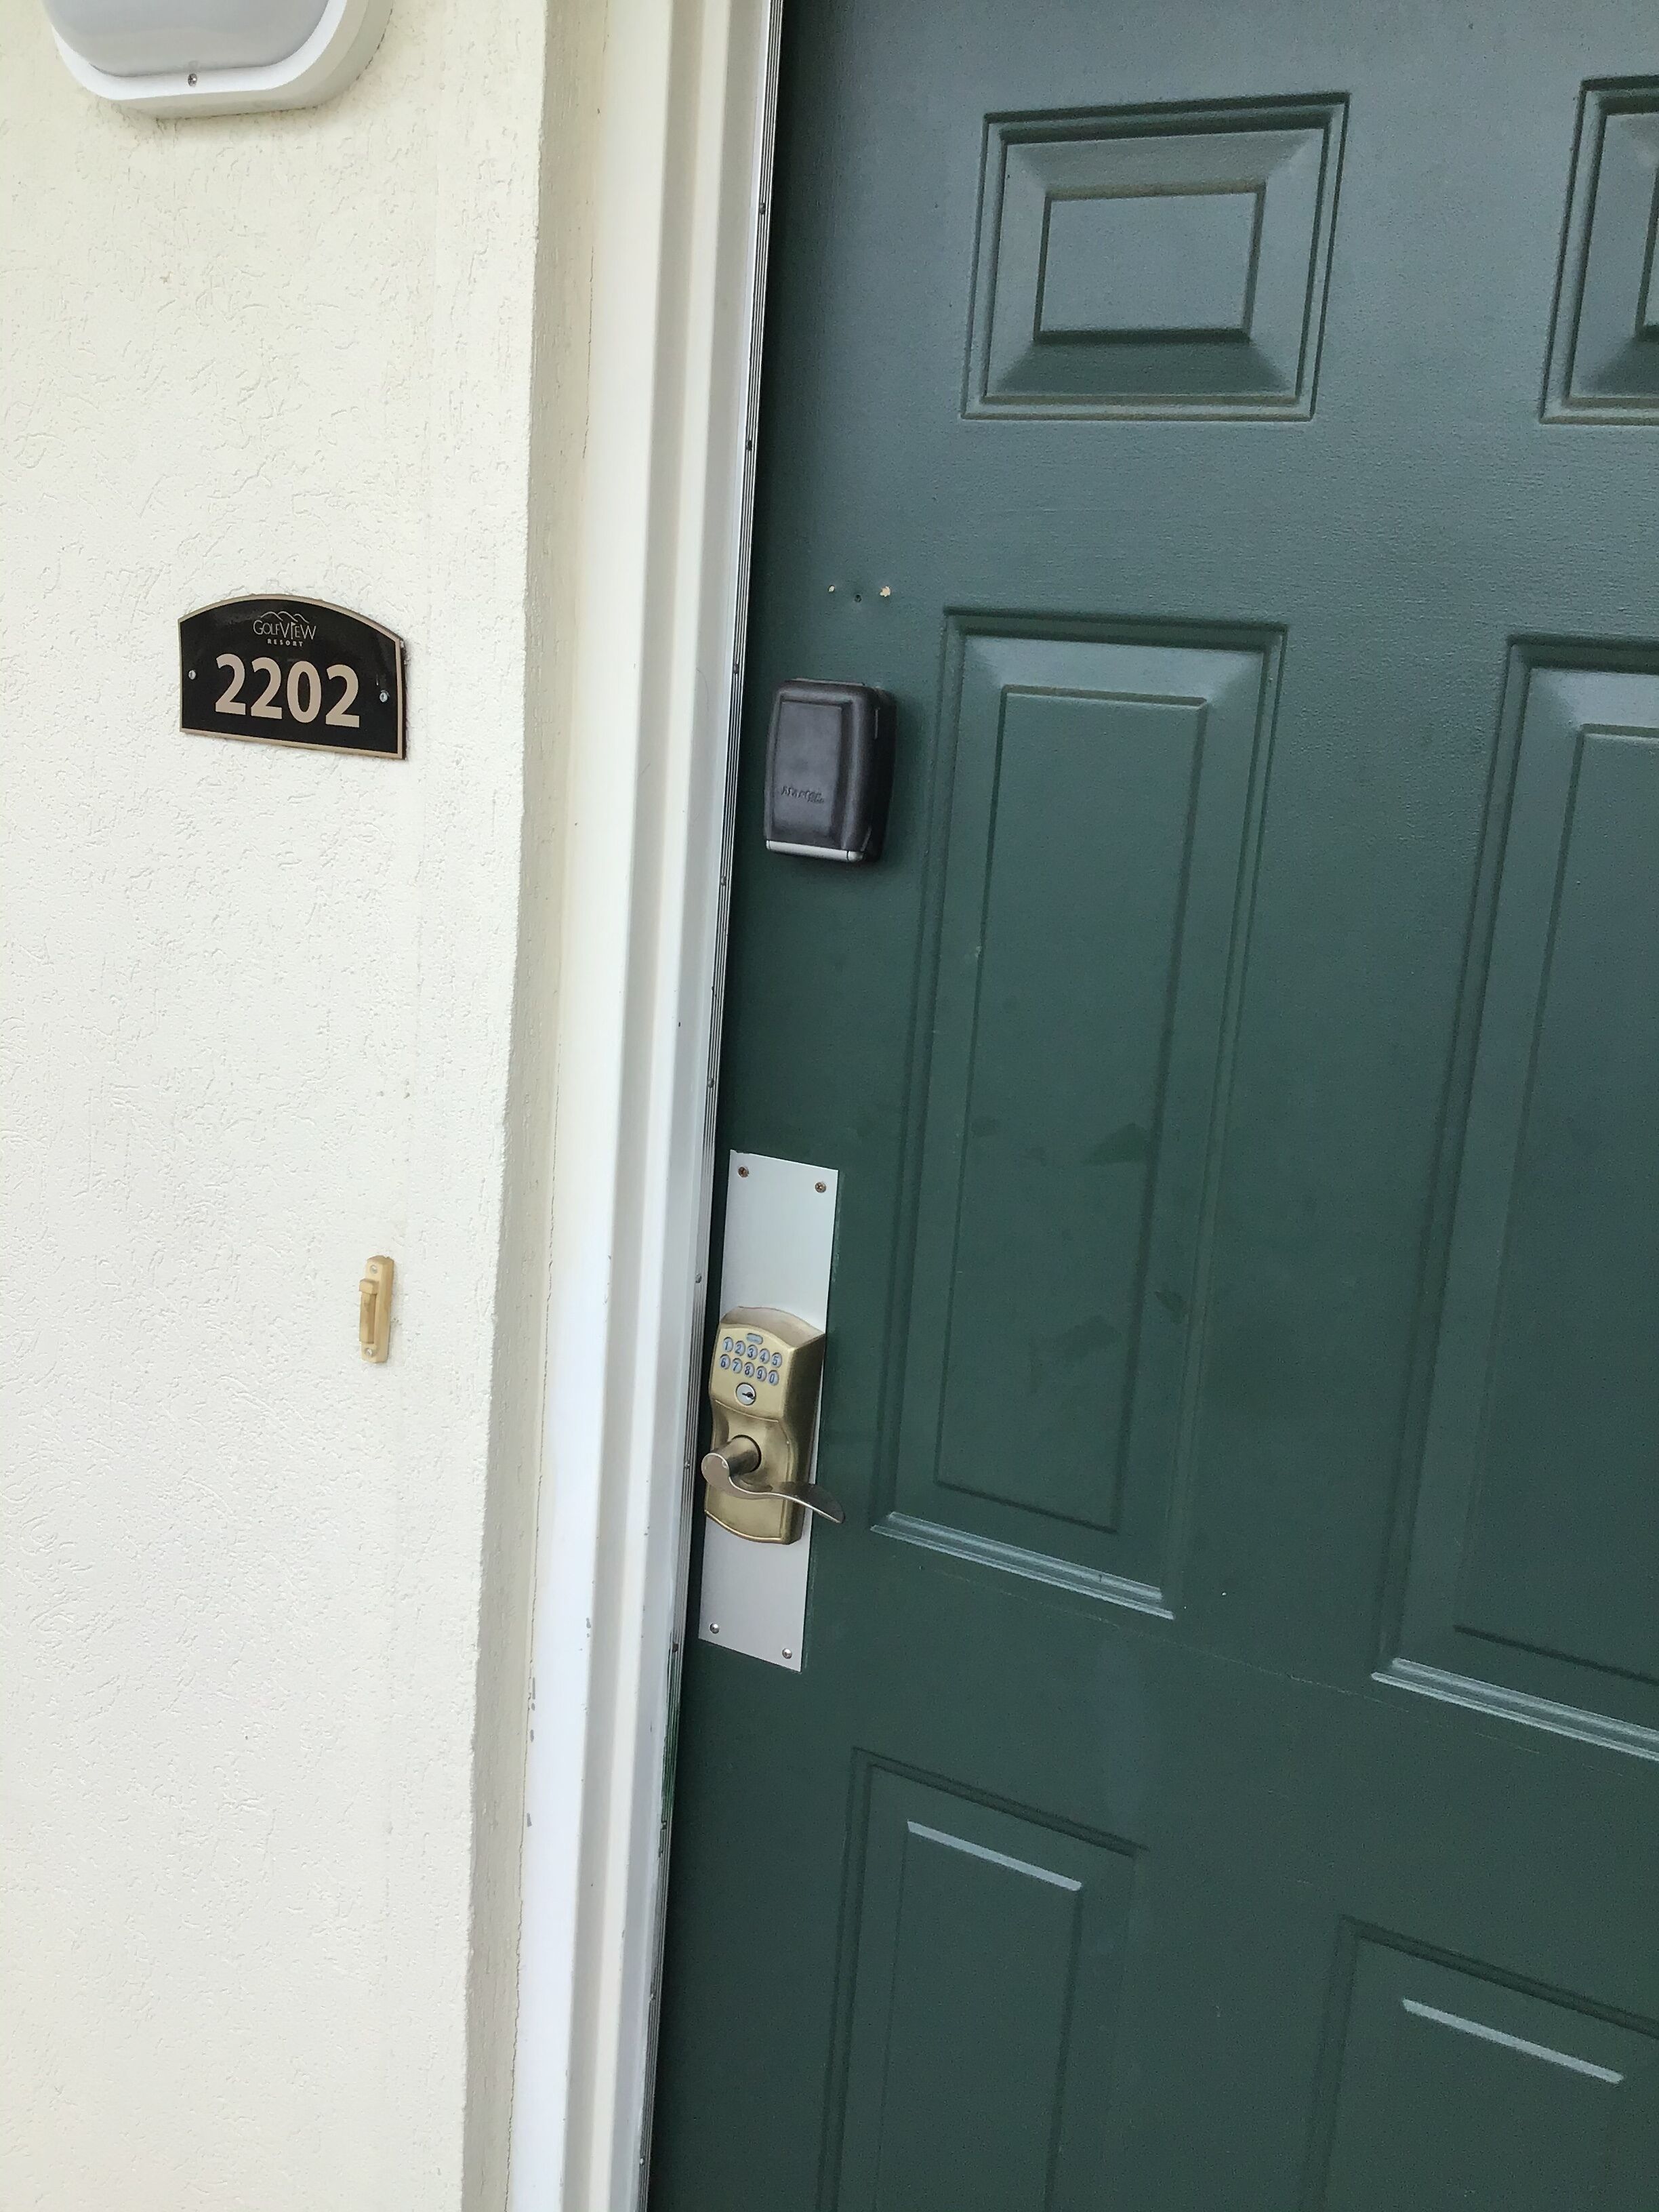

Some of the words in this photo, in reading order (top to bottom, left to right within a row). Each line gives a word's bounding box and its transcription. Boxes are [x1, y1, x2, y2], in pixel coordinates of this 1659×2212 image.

[267, 638, 304, 647] RESORT
[215, 653, 360, 729] 2202
[724, 1340, 729, 1351] 1
[736, 1344, 742, 1354] 2
[747, 1348, 754, 1359] 3
[760, 1351, 766, 1362] 4
[772, 1355, 779, 1366] 5
[720, 1357, 726, 1368] 6
[733, 1361, 739, 1372] 7
[744, 1365, 750, 1376] 8
[757, 1369, 763, 1380] 9
[769, 1373, 775, 1384] 0
